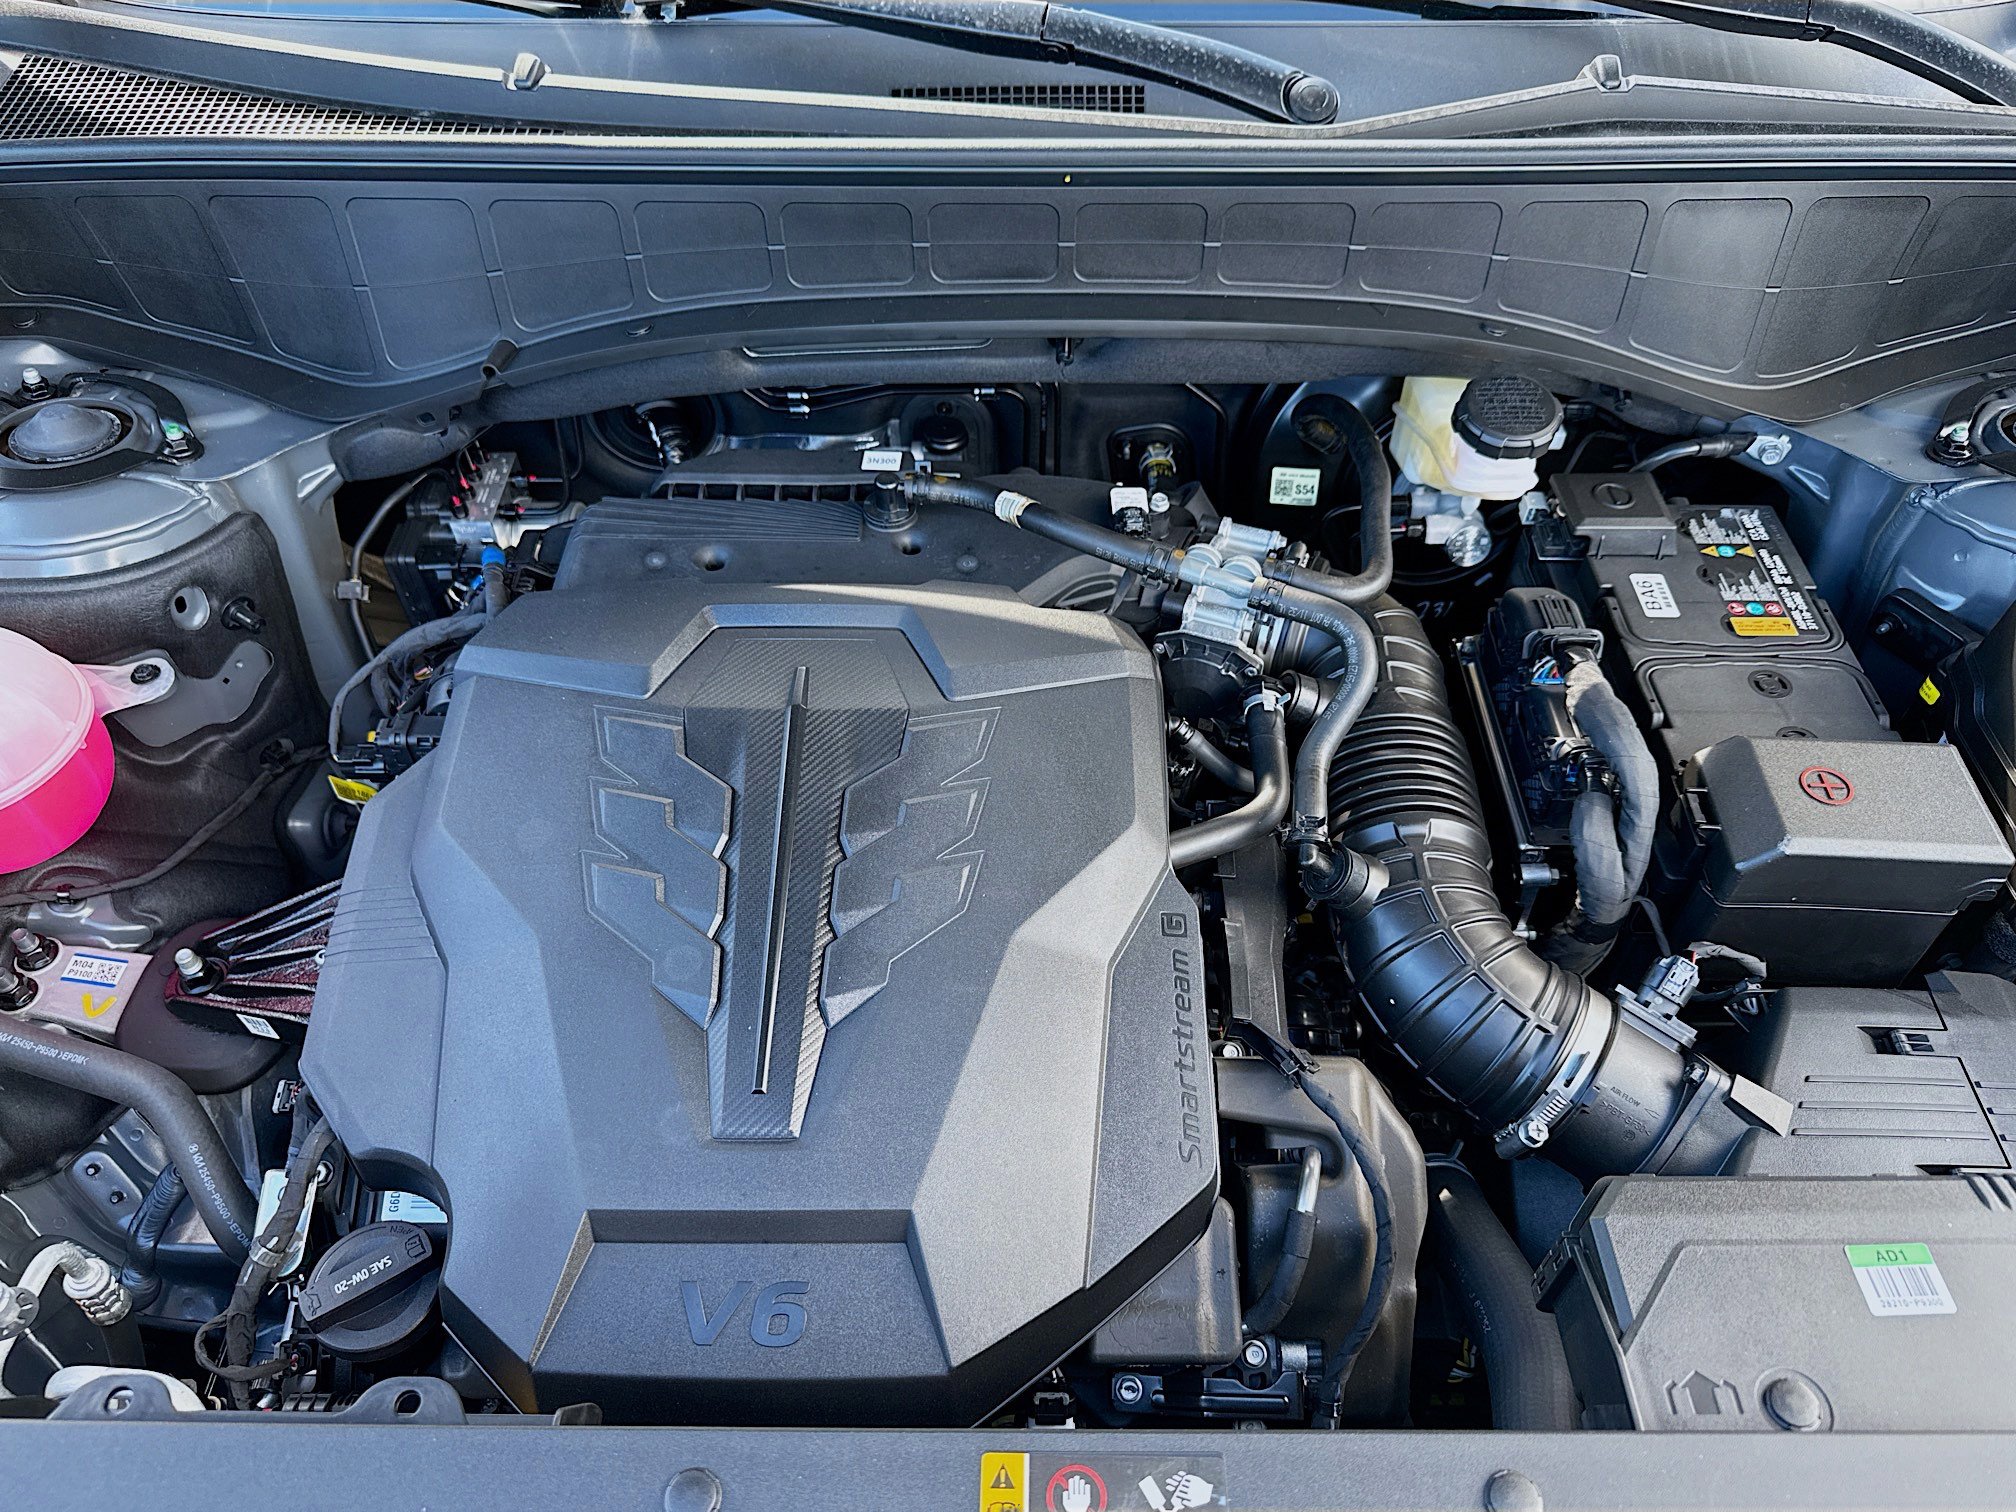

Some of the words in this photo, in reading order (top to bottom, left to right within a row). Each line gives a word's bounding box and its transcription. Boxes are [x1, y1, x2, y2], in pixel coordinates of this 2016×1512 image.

[866, 457, 897, 465] 3N300
[1295, 484, 1315, 495] S54
[1636, 580, 1662, 610] BA6
[1322, 700, 1340, 720] 59120
[67, 969, 93, 978] P9100
[72, 960, 94, 969] M04
[10, 1036, 59, 1058] 25450-P9500
[1171, 948, 1203, 1168] Smartstream
[1610, 1086, 1623, 1097] AIR
[1622, 1092, 1641, 1107] FLOW
[198, 1165, 231, 1219] 25450-P9500
[371, 1255, 393, 1275] SAE
[1876, 1249, 1908, 1263] AD1
[334, 1271, 370, 1295] 0W-20
[681, 1281, 810, 1347] V6
